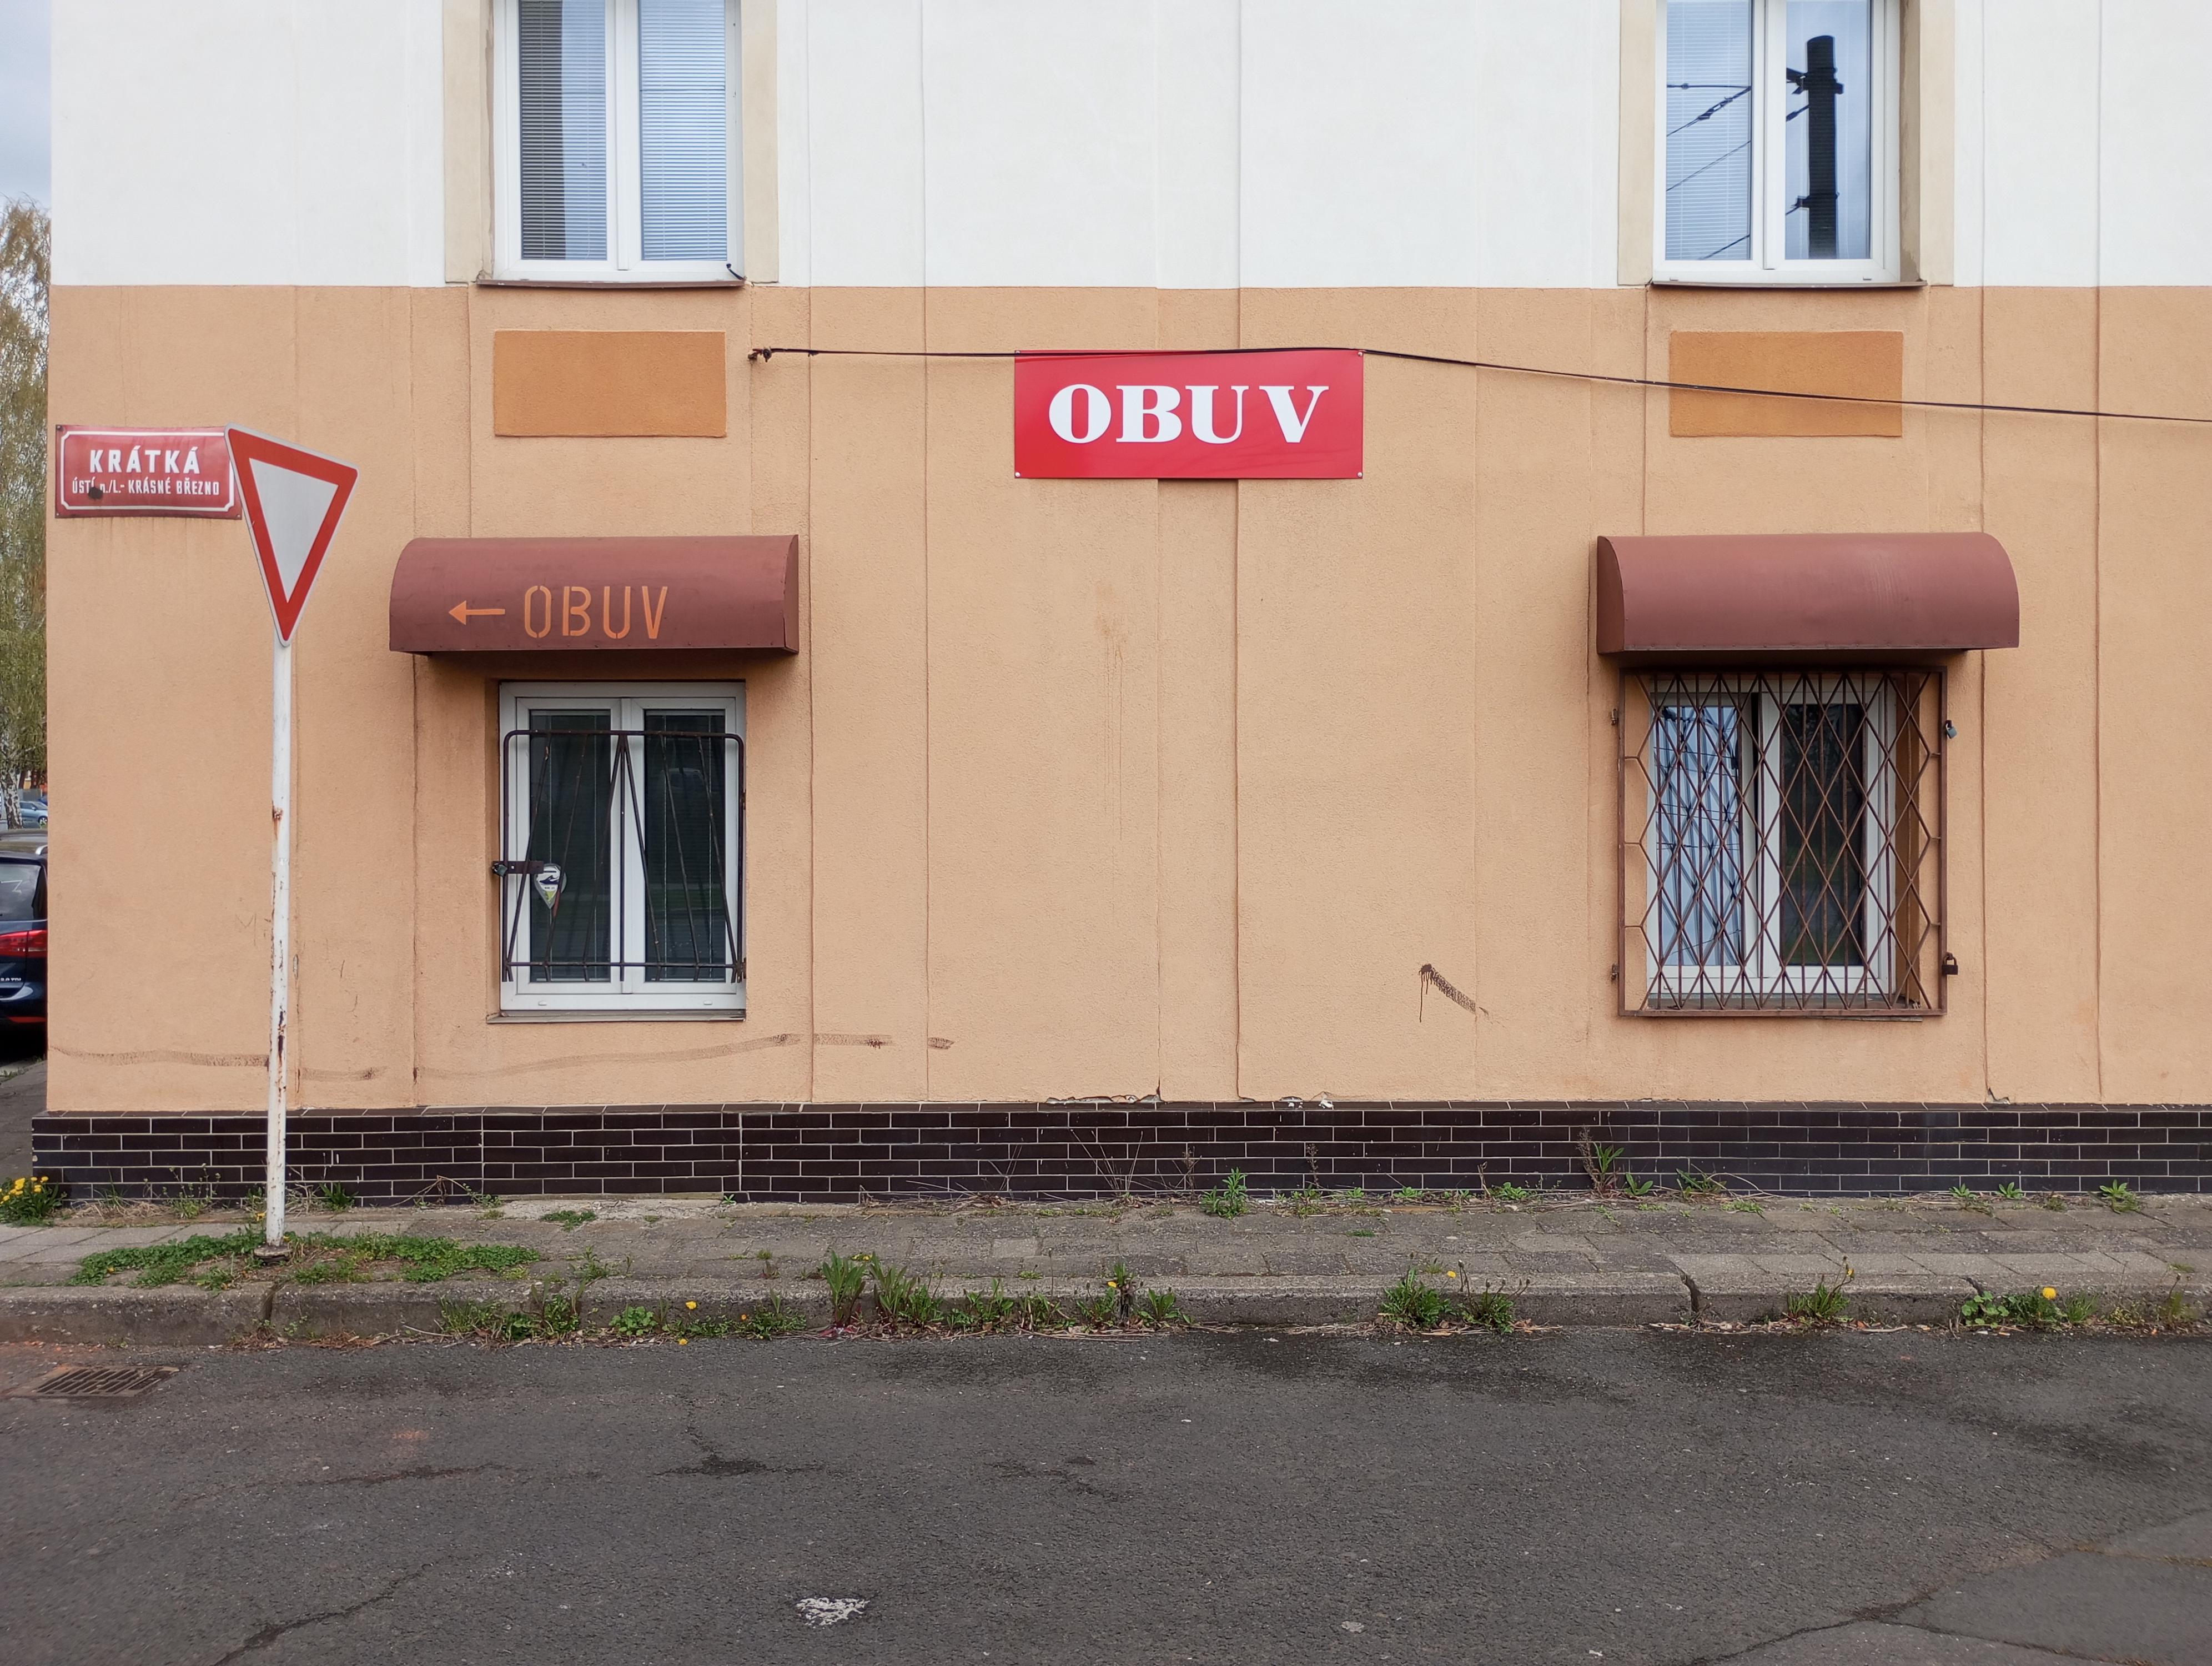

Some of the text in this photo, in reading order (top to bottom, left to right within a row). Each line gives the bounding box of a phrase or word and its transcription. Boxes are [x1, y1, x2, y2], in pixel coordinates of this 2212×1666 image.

[1049, 384, 1329, 444] OBUV
[89, 445, 200, 474] KRÁTKÁ
[128, 476, 171, 494] KRÁSNÉ
[176, 477, 220, 495] BŘEZNO
[524, 586, 667, 639] OBUV
